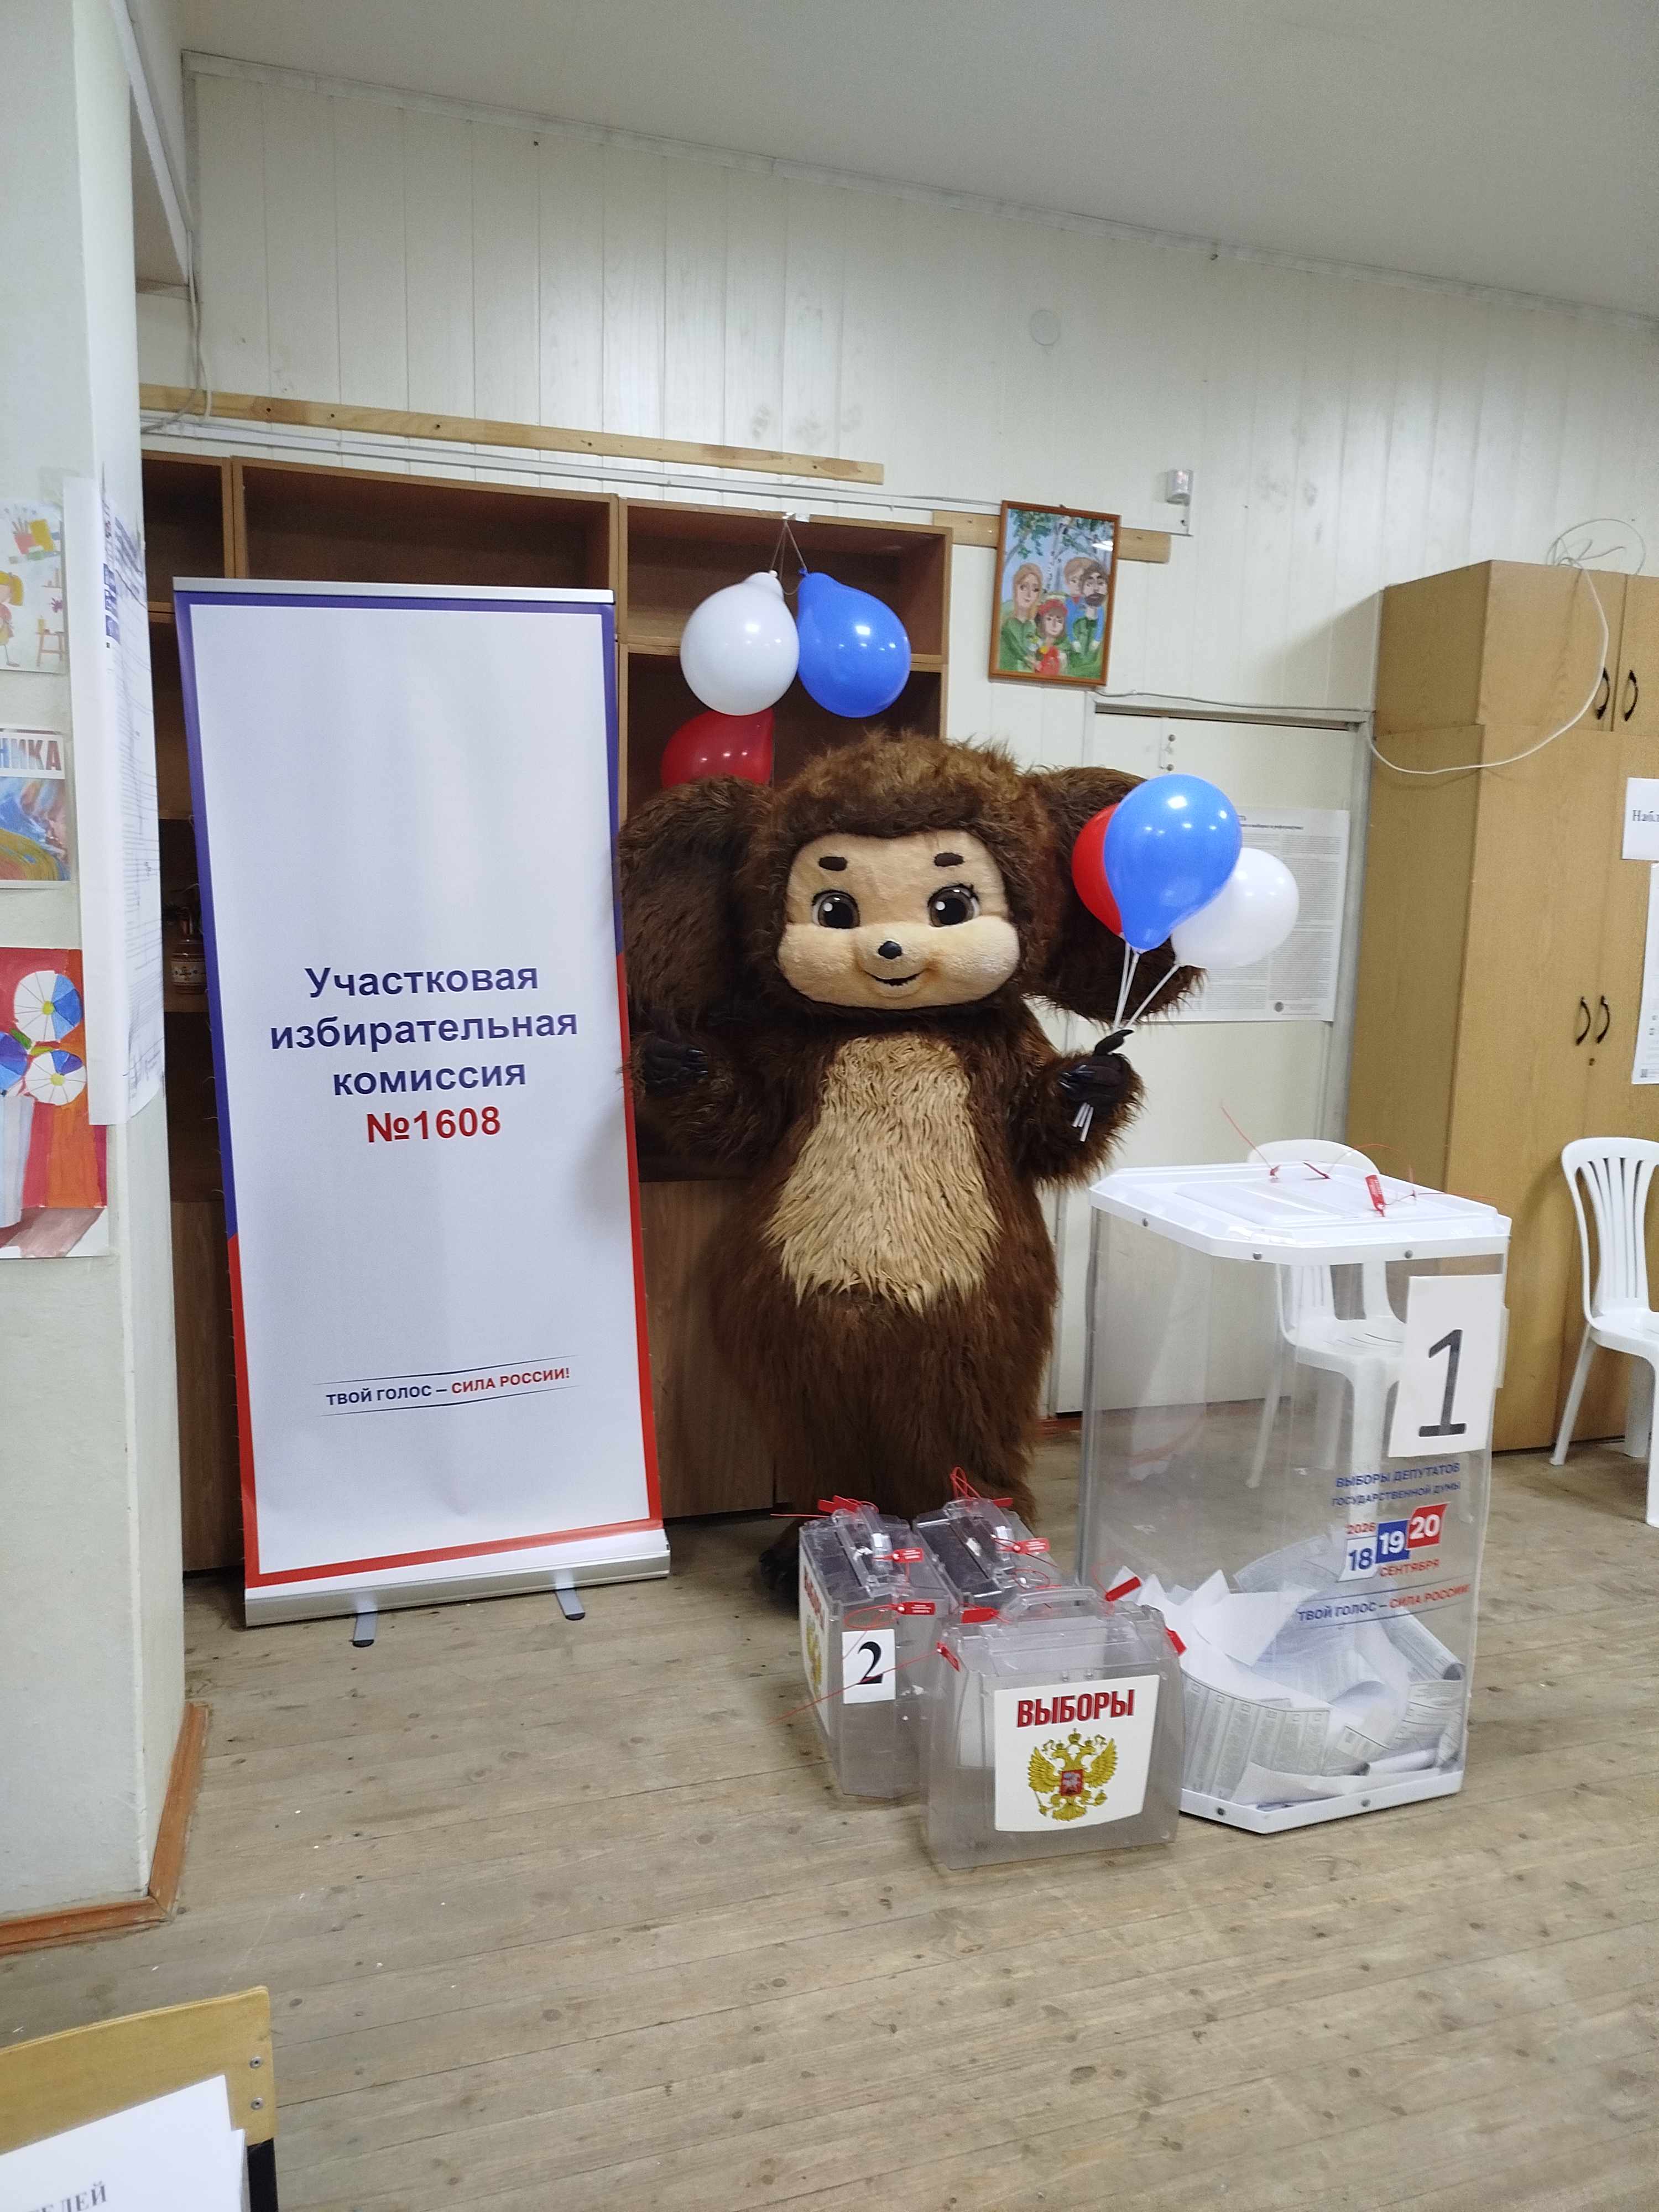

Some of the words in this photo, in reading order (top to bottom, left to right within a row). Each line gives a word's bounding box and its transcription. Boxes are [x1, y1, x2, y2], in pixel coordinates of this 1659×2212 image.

[305, 967, 538, 998] Участковая
[270, 1014, 578, 1052] избирательная
[333, 1064, 526, 1096] комиссия
[367, 1106, 500, 1143] №1608
[326, 1387, 372, 1406] ТВОЙ
[377, 1385, 432, 1401] ГОЛОС
[451, 1378, 496, 1394] СИЛА
[500, 1367, 570, 1387] РОССИИ!
[1418, 1329, 1466, 1437] 1
[1335, 1473, 1390, 1488] ВЫБОРЫ
[1393, 1463, 1460, 1482] ДЕПУТАТОВ
[1331, 1485, 1431, 1507] ГОСУДАРСТВЕННОЙ
[1379, 1530, 1405, 1555] 19
[1408, 1514, 1440, 1540] 20
[1348, 1547, 1374, 1571] 18
[1380, 1559, 1439, 1577] СЕНТЯБРЯ
[1298, 1605, 1333, 1621] ТВОЙ
[1335, 1601, 1377, 1617] ГОЛОС
[1390, 1595, 1422, 1608] СИЛА
[857, 1641, 884, 1685] 2
[1017, 1689, 1135, 1727] ВЫБОРЫ
[29, 2180, 106, 2212] ЛЕЙ
